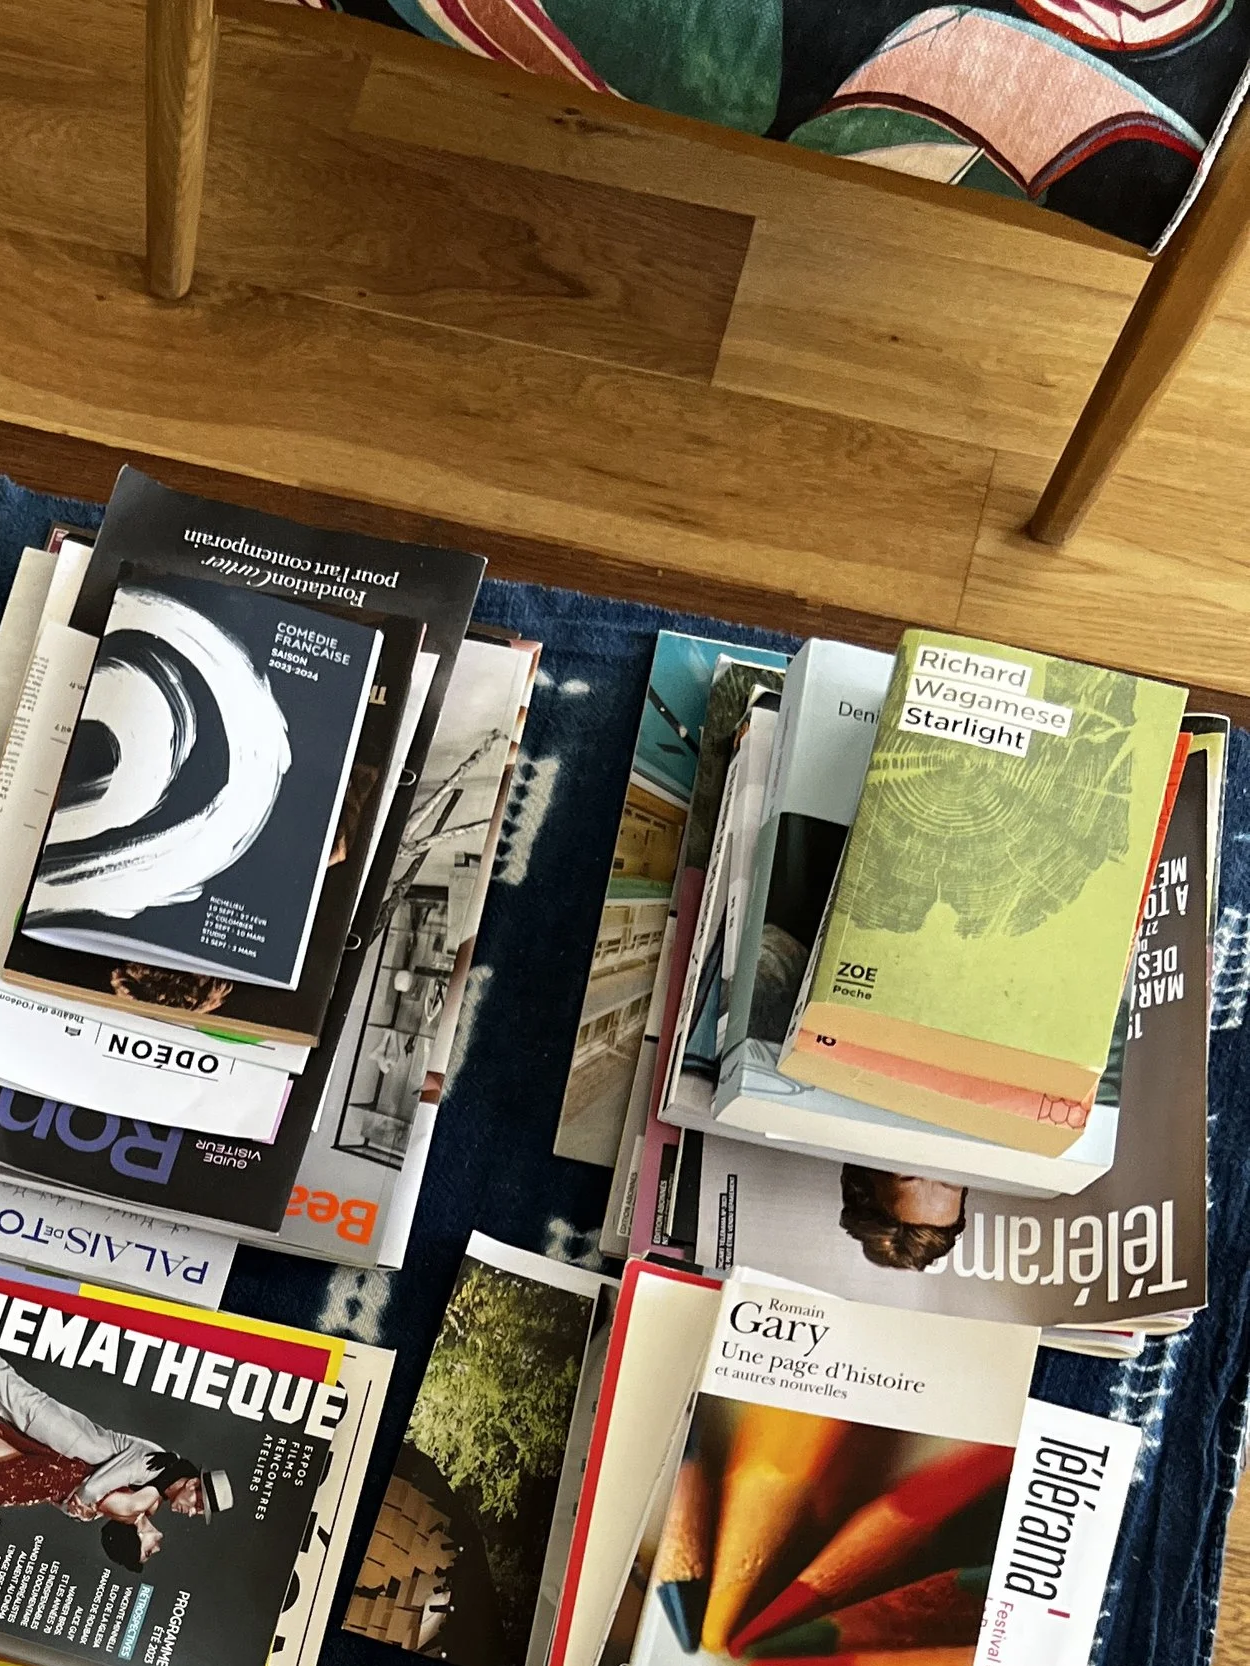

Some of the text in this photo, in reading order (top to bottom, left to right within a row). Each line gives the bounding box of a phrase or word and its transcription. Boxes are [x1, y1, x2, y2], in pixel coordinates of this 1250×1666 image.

[184, 529, 399, 589] pour contemporain
[274, 635, 351, 666] FRANÇAISE
[277, 622, 338, 649] COMÉDIE
[271, 648, 308, 666] SAISON
[920, 648, 1028, 688] Richard
[914, 677, 1068, 730] Wagamese
[905, 706, 1026, 751] Starlight
[836, 960, 878, 984] ZOE
[1135, 946, 1178, 980] DES
[833, 985, 872, 1001] Poche
[108, 1033, 219, 1074] ODÉON
[195, 1139, 261, 1162] VISITEUR
[203, 1152, 247, 1170] GUIDE
[64, 1227, 209, 1285] PALAIS
[930, 1200, 1189, 1308] Téléram
[768, 1298, 825, 1319] Romain
[729, 1300, 830, 1357] Gary
[715, 1366, 848, 1400] et autres nouvelles
[721, 1341, 926, 1395] Une page d'histoire
[247, 1432, 273, 1493] ATELIERS
[281, 1440, 299, 1479] FILMS
[292, 1443, 314, 1487] EXPOS
[253, 1436, 286, 1522] RENCONTRES
[1004, 1435, 1111, 1601] Télérama
[92, 1567, 110, 1603] FRANÇOIS
[107, 1583, 119, 1602] ELOY
[115, 1585, 133, 1620] VINCENTE
[66, 1605, 83, 1641] ALICE GUY
[89, 1603, 99, 1614] DE
[100, 1613, 109, 1623] LA
[104, 1602, 113, 1613] DE
[120, 1585, 150, 1658] RÉTROSPECTIVES
[143, 1625, 164, 1664] ÉTÉ 2023
[988, 1600, 1014, 1665] Festival
